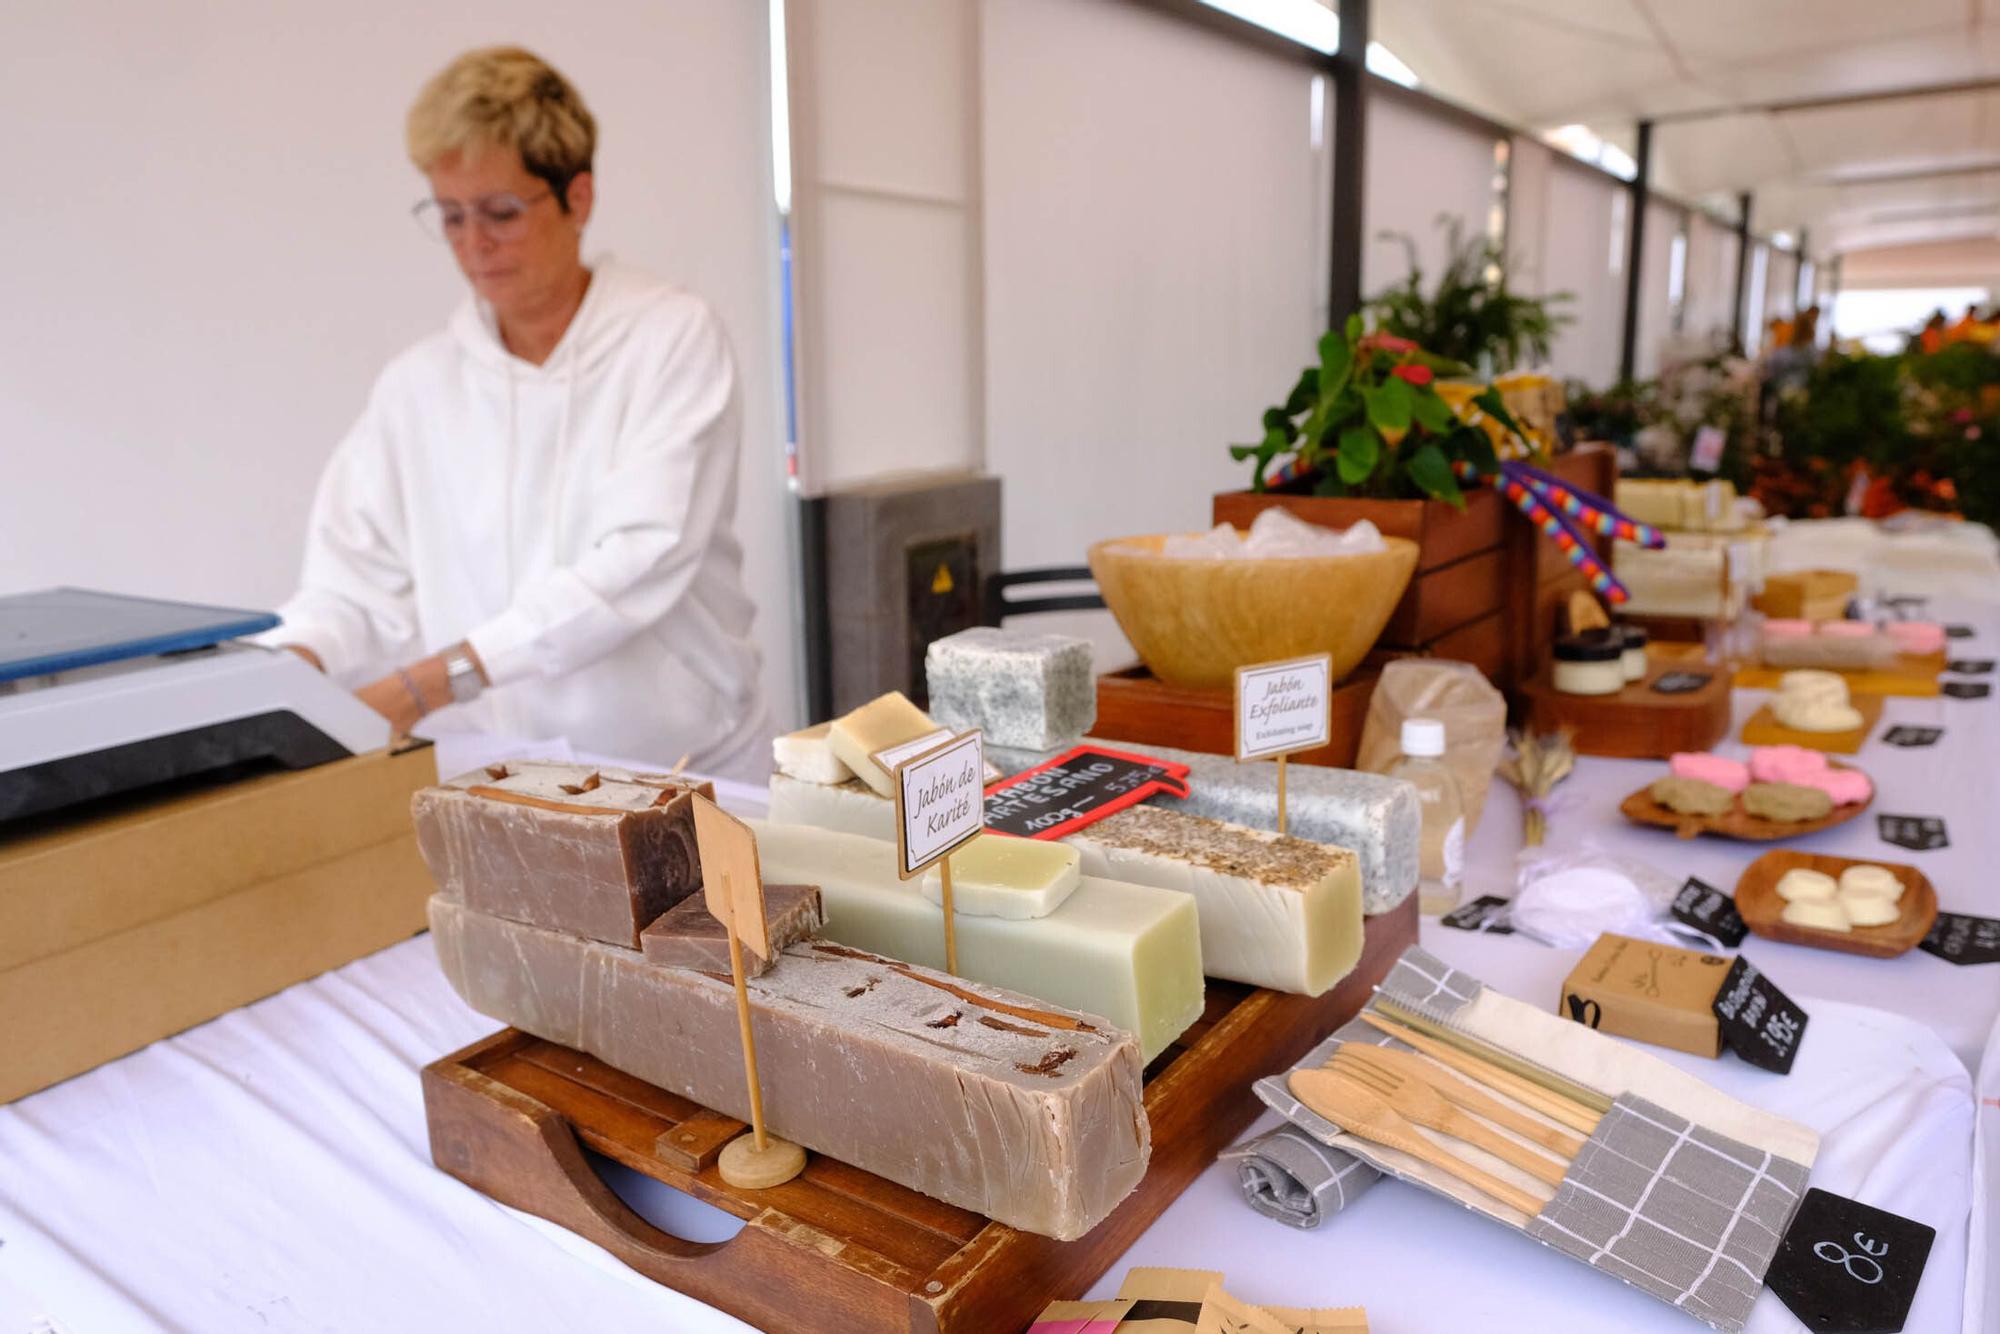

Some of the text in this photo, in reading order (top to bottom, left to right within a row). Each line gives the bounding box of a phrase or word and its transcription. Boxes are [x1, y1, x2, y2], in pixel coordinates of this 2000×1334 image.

[1249, 695, 1318, 726] Exfoliante
[1261, 675, 1304, 701] Jabón
[913, 760, 975, 819] Jabón de
[927, 793, 971, 838] Karité
[1812, 1231, 1889, 1284] 8€
